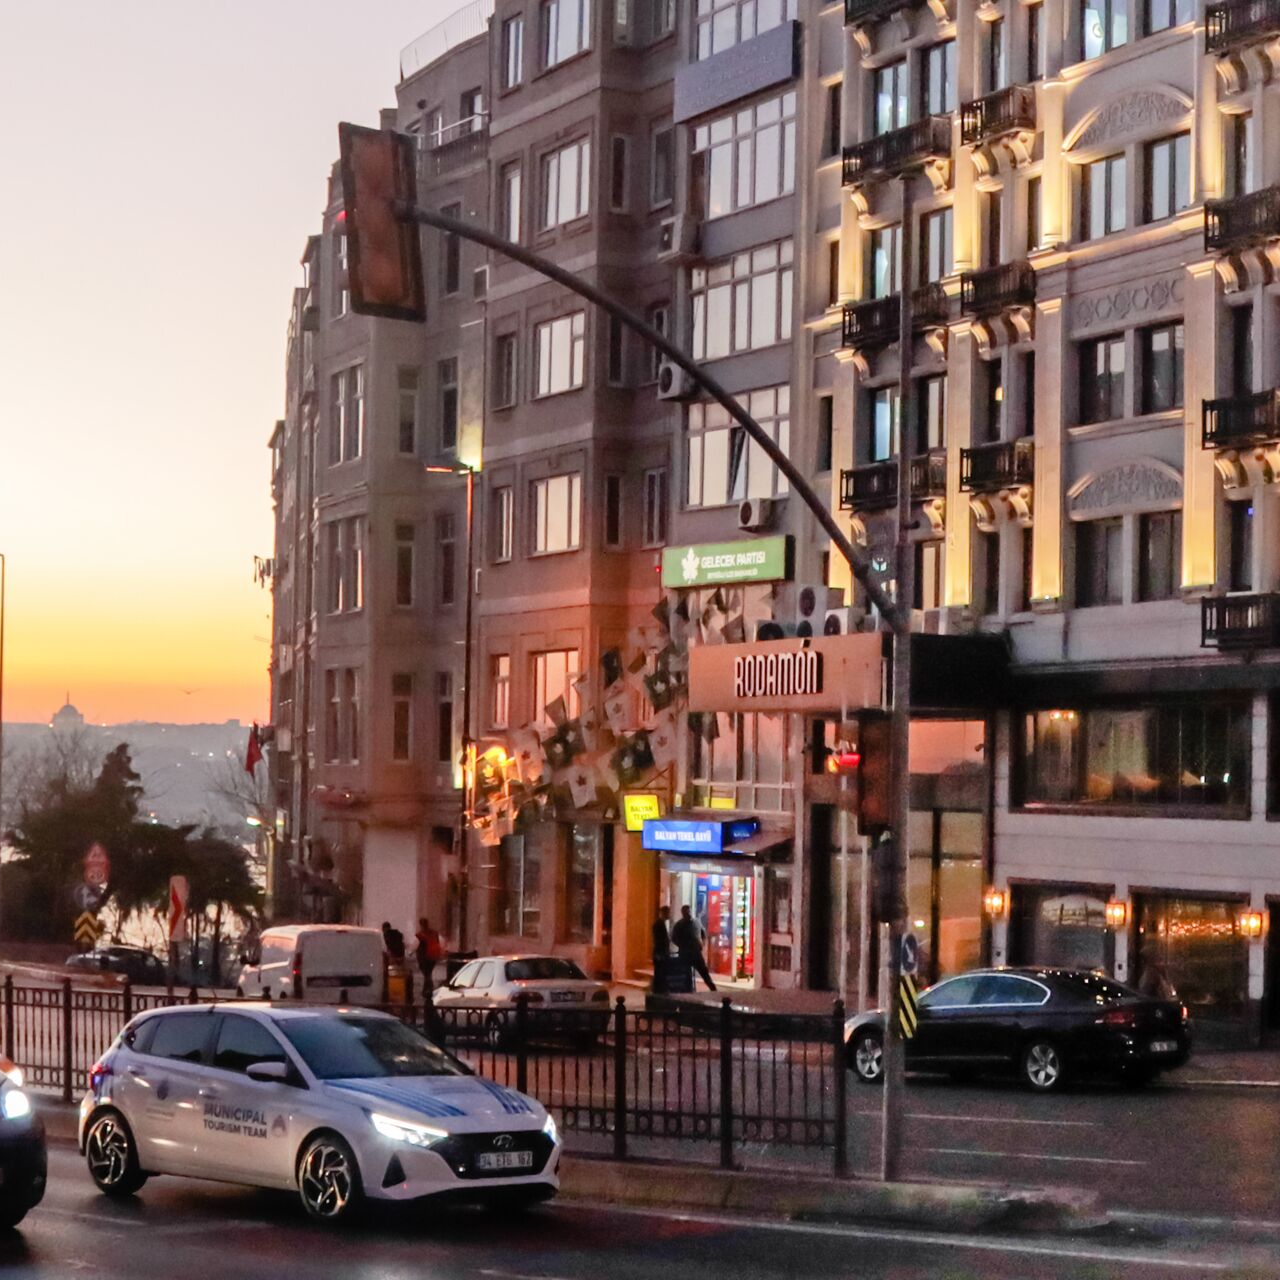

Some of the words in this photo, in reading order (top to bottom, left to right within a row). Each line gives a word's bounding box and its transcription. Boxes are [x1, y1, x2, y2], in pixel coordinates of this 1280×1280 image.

[701, 554, 735, 569] GELECEK
[654, 830, 677, 841] BALYAN
[203, 1103, 268, 1126] MUNICIPAL
[203, 1118, 241, 1133] TOURISM
[243, 1125, 268, 1139] TEAM
[481, 1154, 492, 1169] 34
